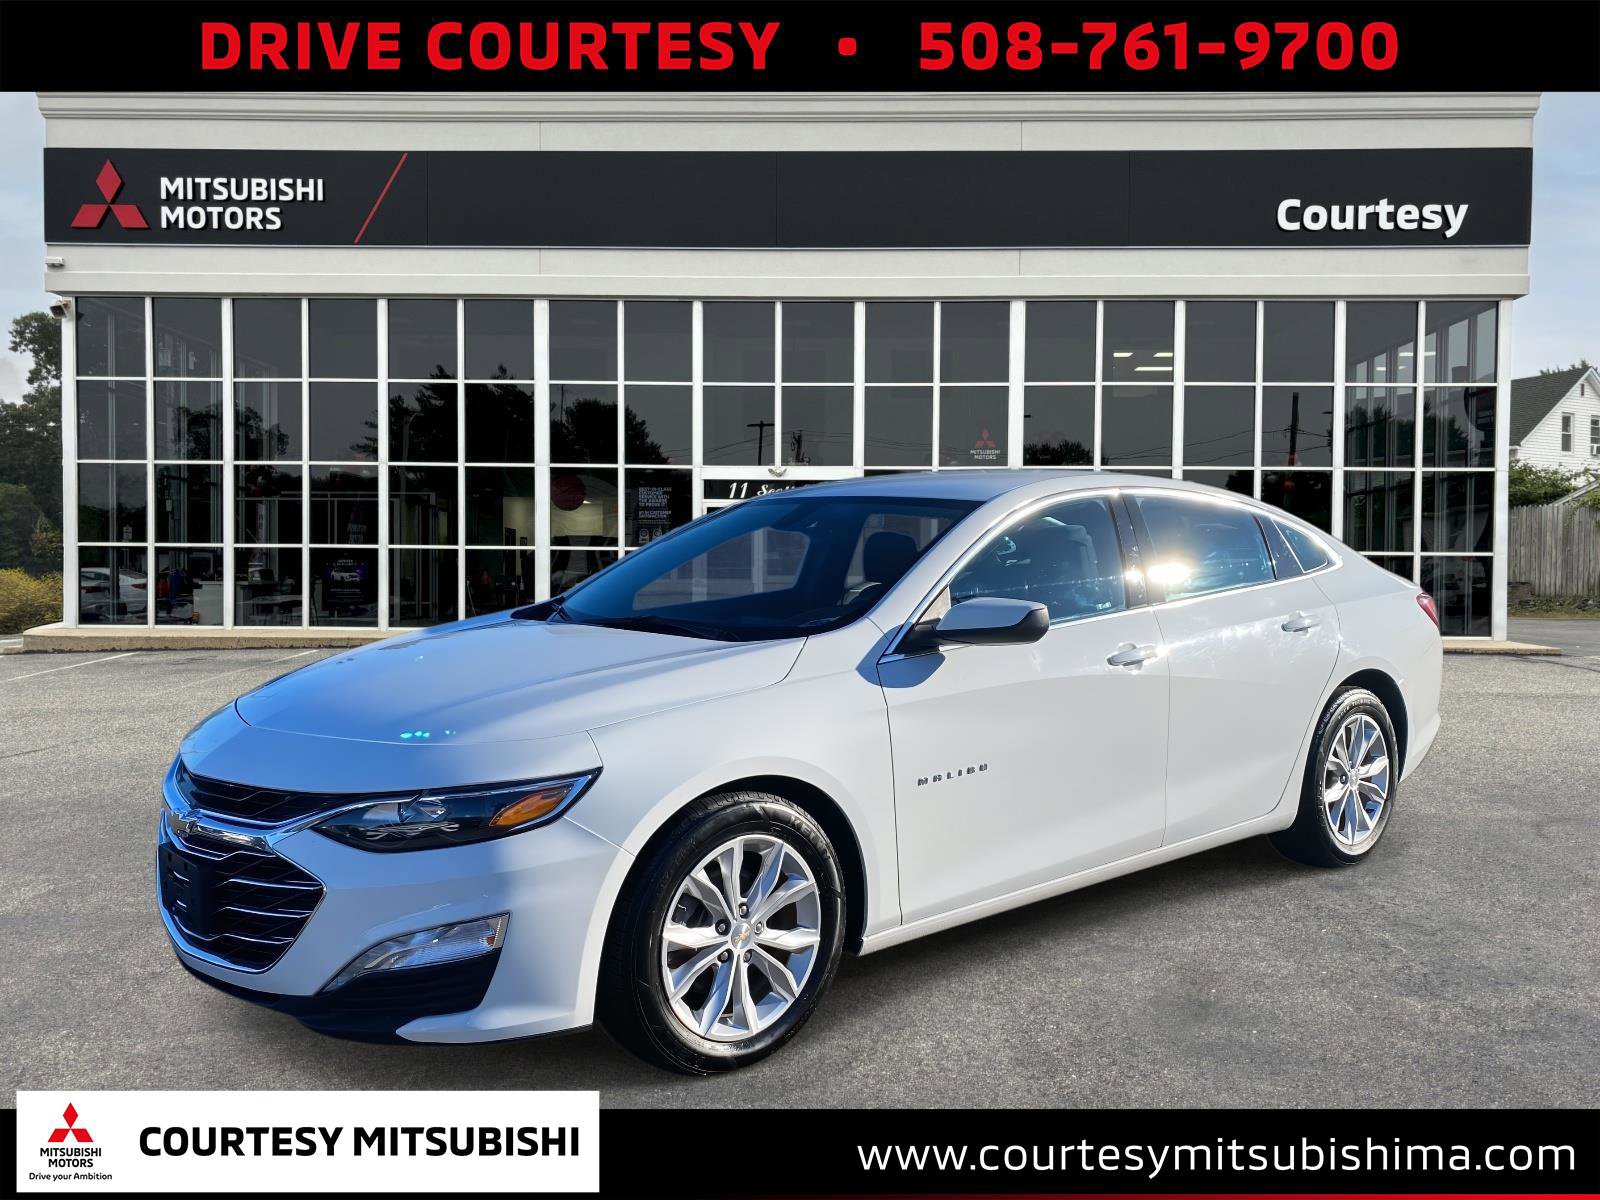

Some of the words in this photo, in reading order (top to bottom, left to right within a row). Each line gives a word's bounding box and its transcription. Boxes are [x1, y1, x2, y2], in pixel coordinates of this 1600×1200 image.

[160, 176, 325, 202] MITSUBISHI
[160, 206, 283, 231] MOTORS
[1277, 199, 1469, 238] Courtesy
[729, 482, 748, 499] 11
[917, 763, 988, 787] MALIBU
